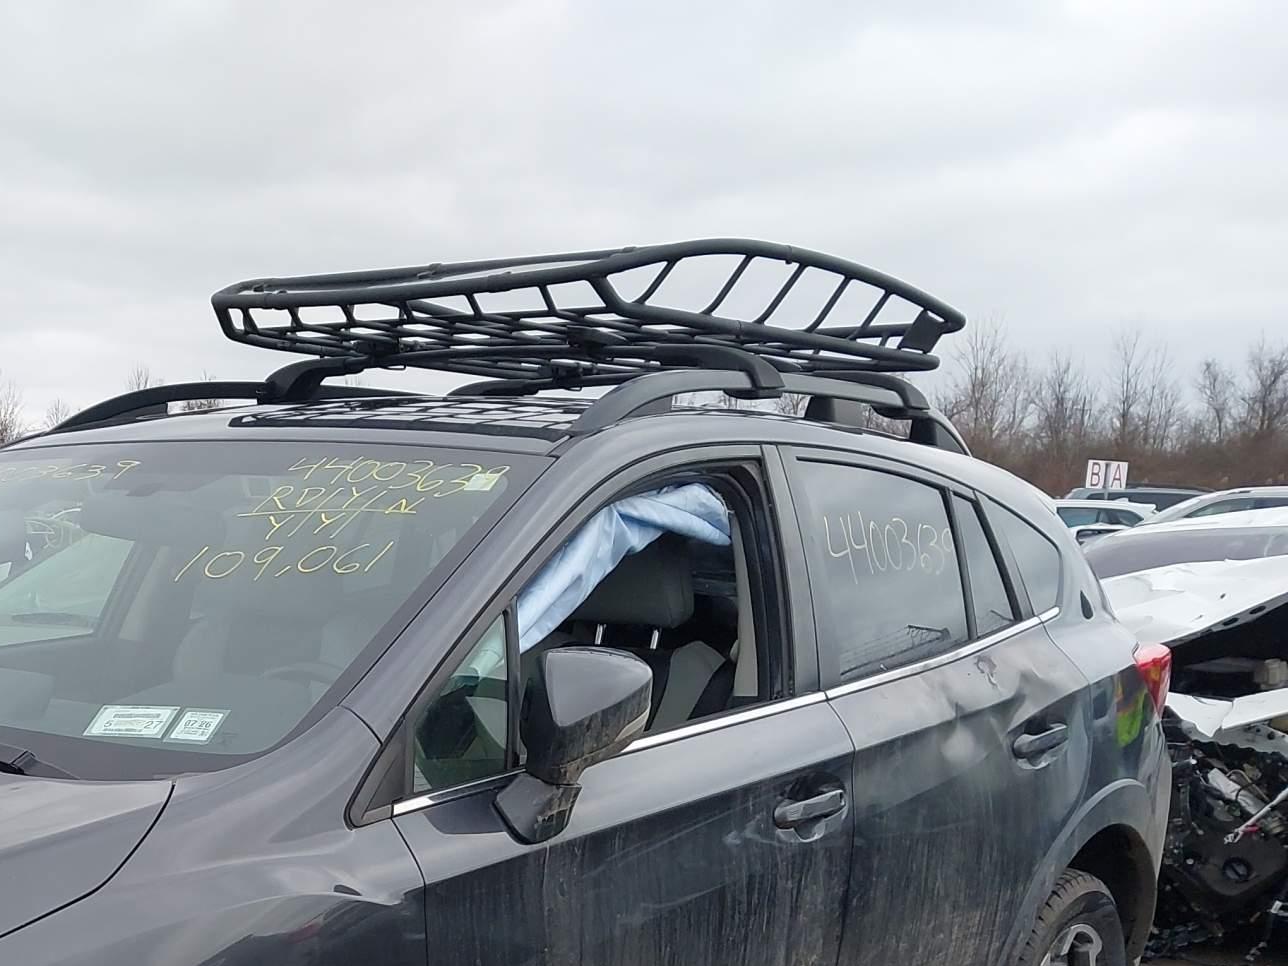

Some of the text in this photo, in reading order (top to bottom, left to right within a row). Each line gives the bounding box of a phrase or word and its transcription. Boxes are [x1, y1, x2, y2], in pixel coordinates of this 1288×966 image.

[288, 456, 511, 498] 44003639
[1090, 462, 1123, 488] B A
[173, 540, 394, 582] 109,061
